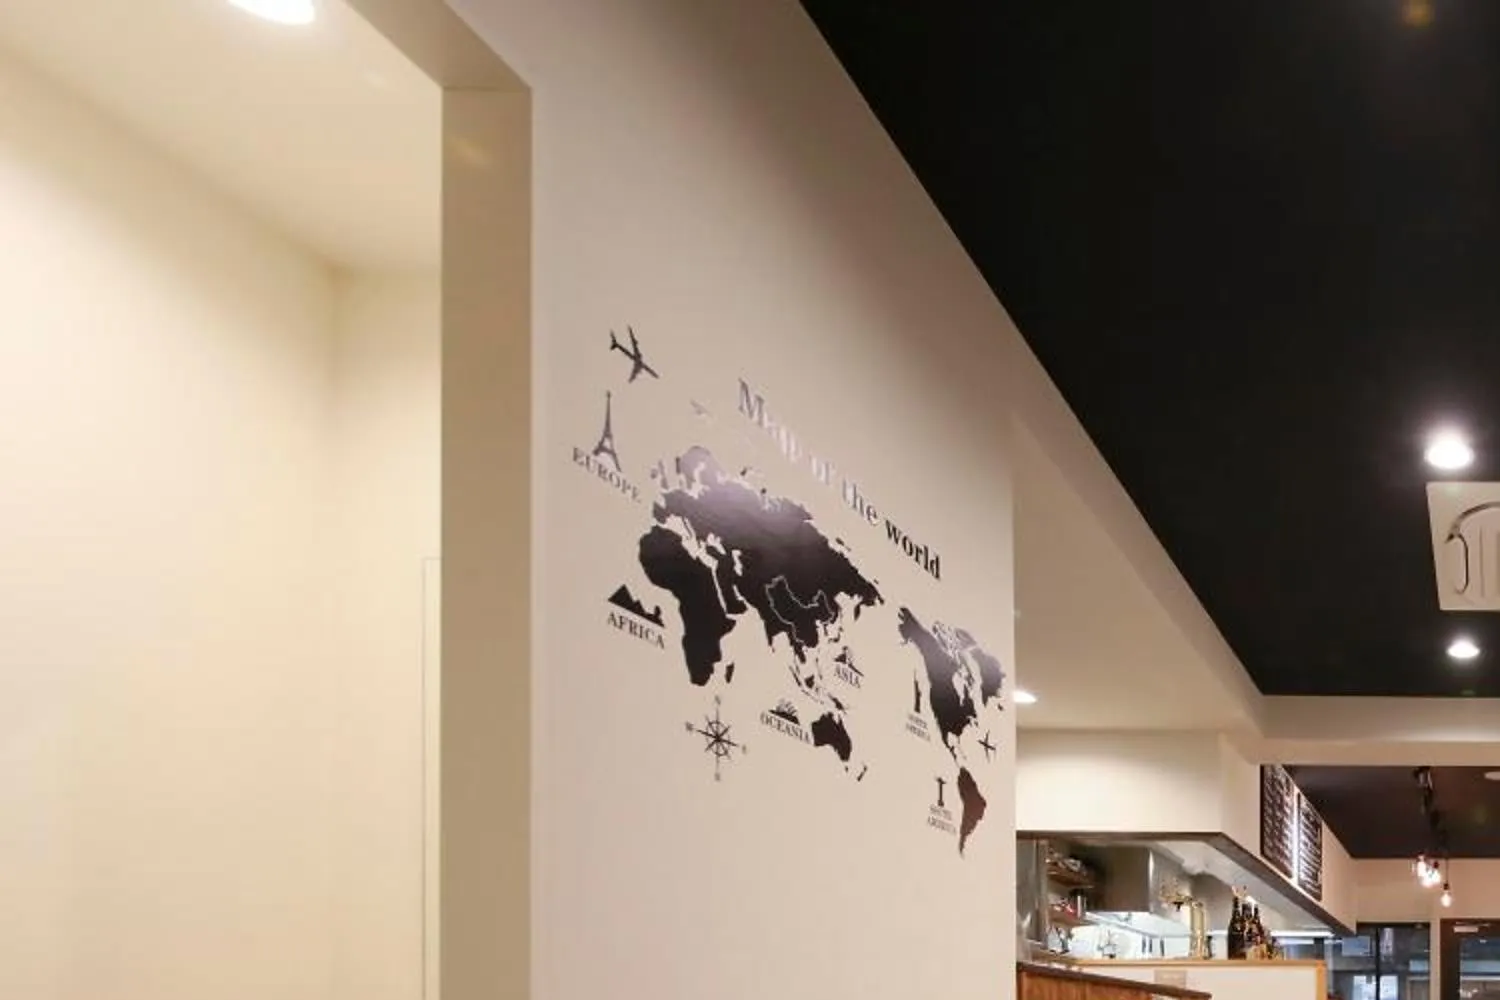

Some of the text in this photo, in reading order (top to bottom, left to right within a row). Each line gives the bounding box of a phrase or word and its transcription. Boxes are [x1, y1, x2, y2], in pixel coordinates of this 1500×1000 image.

[573, 447, 641, 503] EUROPE
[842, 479, 880, 526] the
[884, 517, 941, 580] world
[607, 612, 664, 649] AFRICA
